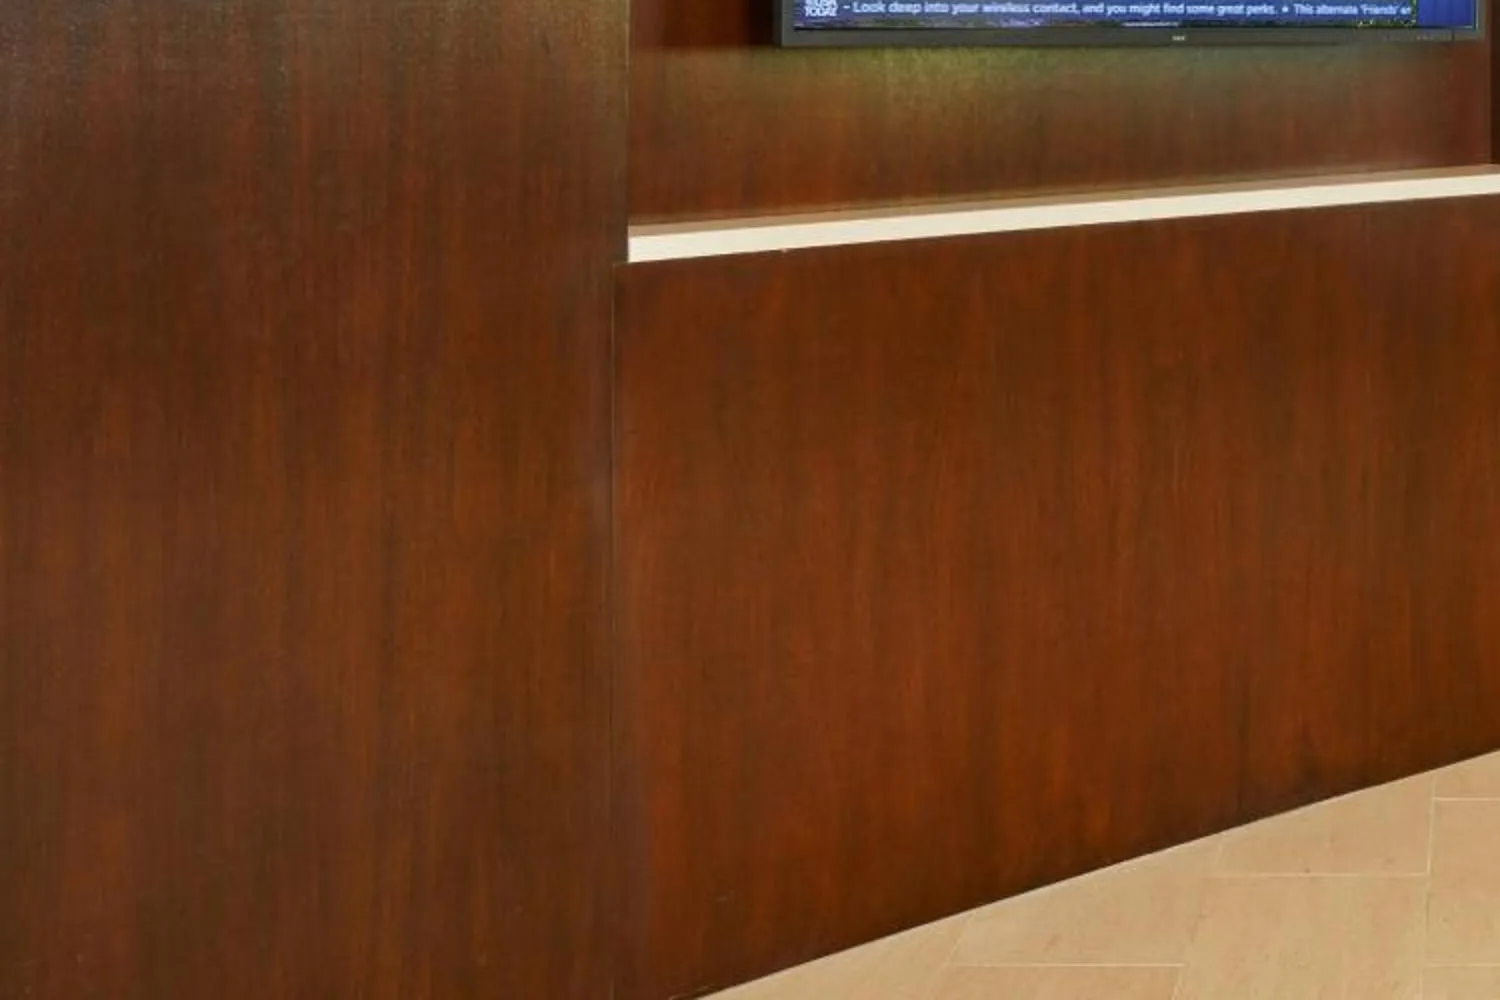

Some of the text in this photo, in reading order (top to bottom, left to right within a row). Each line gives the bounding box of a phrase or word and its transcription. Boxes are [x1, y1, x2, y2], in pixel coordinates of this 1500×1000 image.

[852, 1, 885, 13] Look
[888, 1, 922, 15] deep
[924, 1, 949, 13] into
[951, 4, 979, 15] your
[1082, 2, 1104, 13] and
[1107, 5, 1127, 16] you
[1129, 3, 1160, 16] might
[1163, 3, 1184, 14] find
[1186, 5, 1214, 14] some
[1217, 4, 1244, 16] great
[1294, 3, 1314, 14] This
